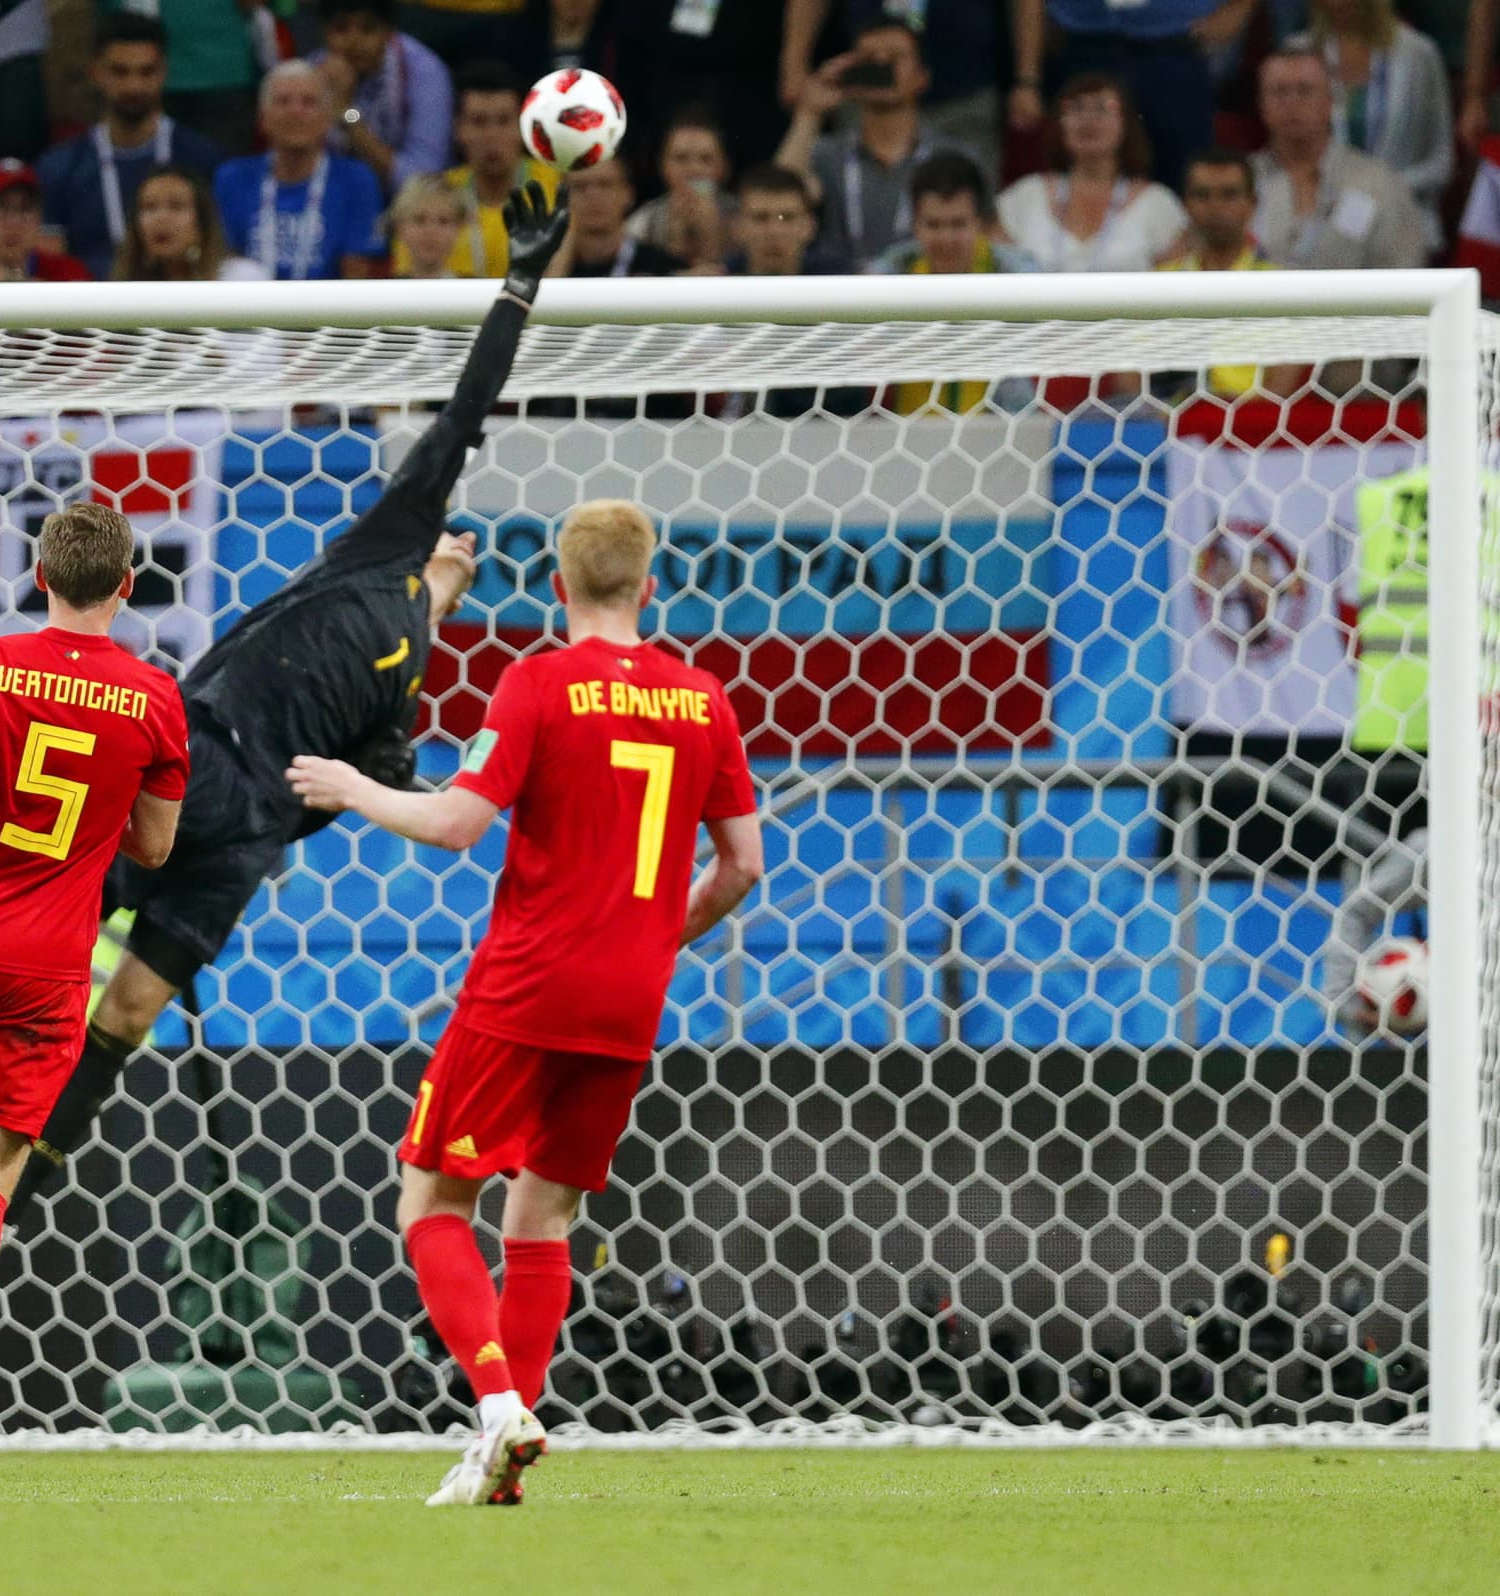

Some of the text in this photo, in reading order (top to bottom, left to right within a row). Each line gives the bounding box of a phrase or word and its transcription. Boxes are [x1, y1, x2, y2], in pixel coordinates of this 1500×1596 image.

[567, 681, 711, 726] DE BRUYNE
[610, 739, 676, 900] 7
